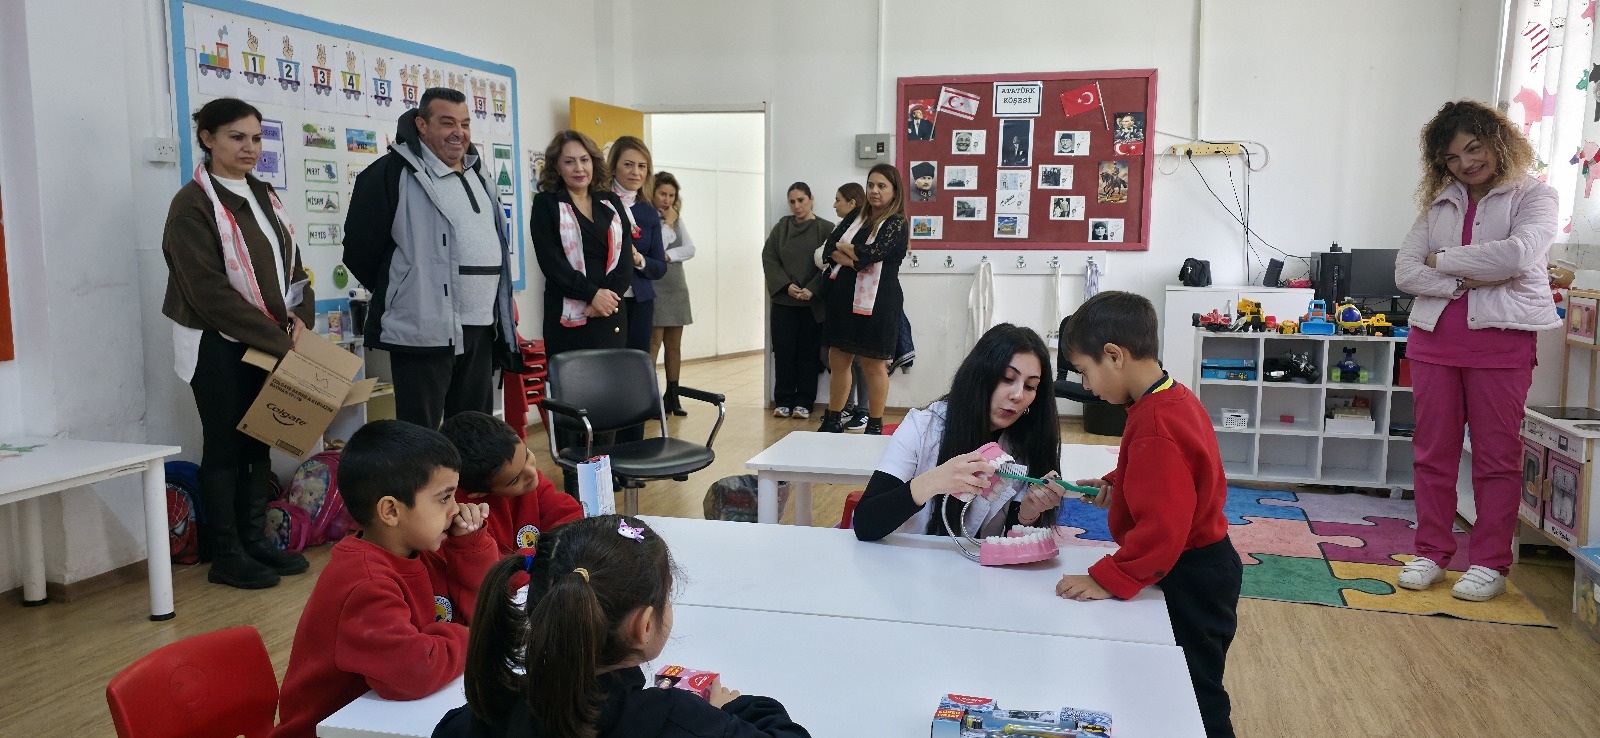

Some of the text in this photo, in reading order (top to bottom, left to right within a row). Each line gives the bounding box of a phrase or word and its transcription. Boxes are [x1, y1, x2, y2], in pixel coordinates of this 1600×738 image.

[251, 56, 257, 73] 1
[284, 63, 293, 79] 2
[319, 70, 326, 84] 3
[347, 75, 355, 90] 4
[379, 82, 386, 95] 5
[407, 88, 414, 100] 6
[1001, 86, 1036, 94] ATATÜRK
[478, 99, 483, 110] 9
[1003, 96, 1032, 106] KÖŞESİ
[496, 103, 503, 113] 10
[266, 402, 306, 426] Colgate
